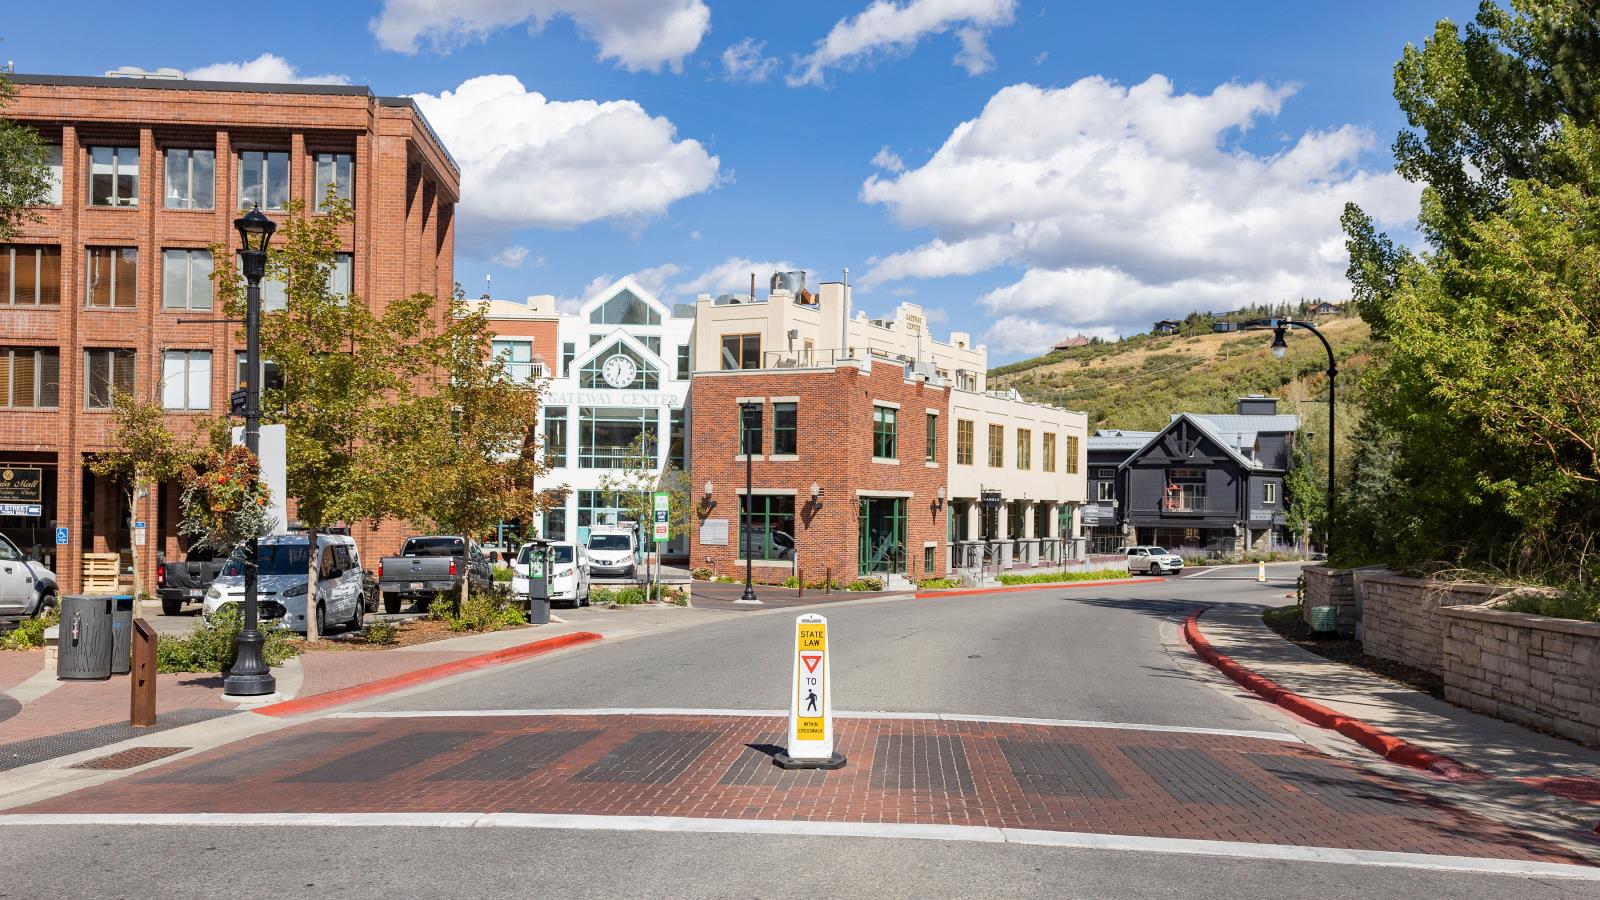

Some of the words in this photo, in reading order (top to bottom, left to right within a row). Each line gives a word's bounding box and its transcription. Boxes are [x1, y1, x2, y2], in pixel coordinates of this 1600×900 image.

[906, 314, 922, 324] GATEWAY
[906, 322, 920, 332] CENTER
[548, 392, 614, 404] GATEWAY
[622, 393, 680, 406] CENTER
[14, 480, 38, 488] Mall
[806, 678, 816, 686] TO
